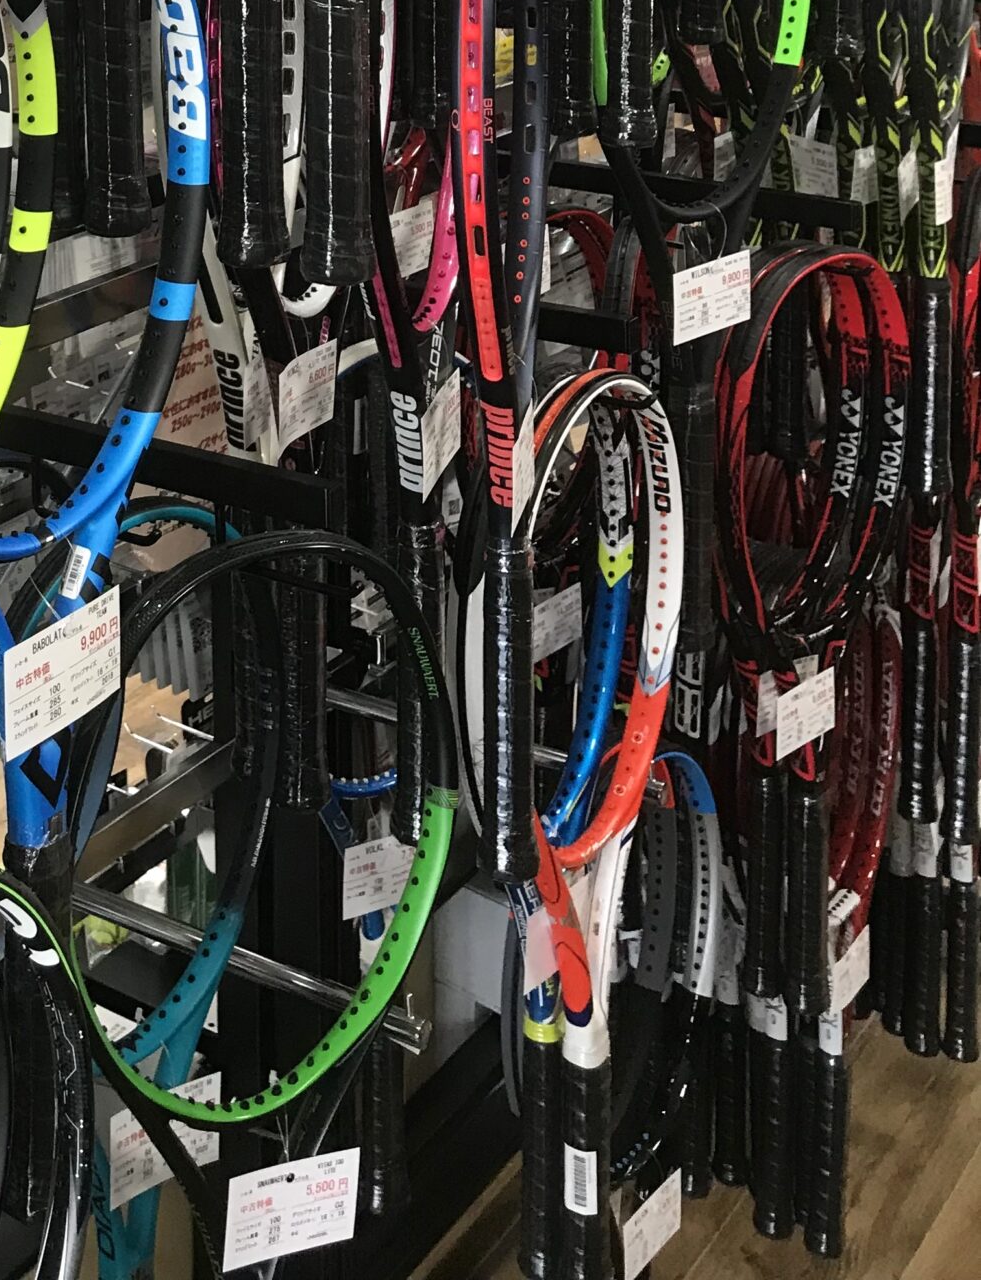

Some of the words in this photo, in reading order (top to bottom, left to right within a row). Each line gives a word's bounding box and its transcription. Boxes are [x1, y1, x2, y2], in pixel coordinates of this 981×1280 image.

[483, 98, 494, 144] BEAST
[390, 390, 423, 493] prince
[480, 400, 515, 508] prince
[637, 406, 671, 513] MIZUNO
[830, 432, 860, 498] YONEX
[873, 440, 904, 508] YONEX
[101, 594, 114, 607] DRIVE
[16, 662, 51, 689] 中古特価
[80, 623, 107, 651] 9,900
[109, 617, 118, 634] 円
[33, 628, 63, 654] BABOLAT
[108, 647, 116, 658] G1
[409, 627, 439, 699] SNAUWAERT
[49, 683, 61, 696] 100
[49, 696, 61, 708] 285
[50, 708, 61, 720] 280
[306, 1180, 335, 1196] 5,500
[339, 1178, 348, 1190] 円
